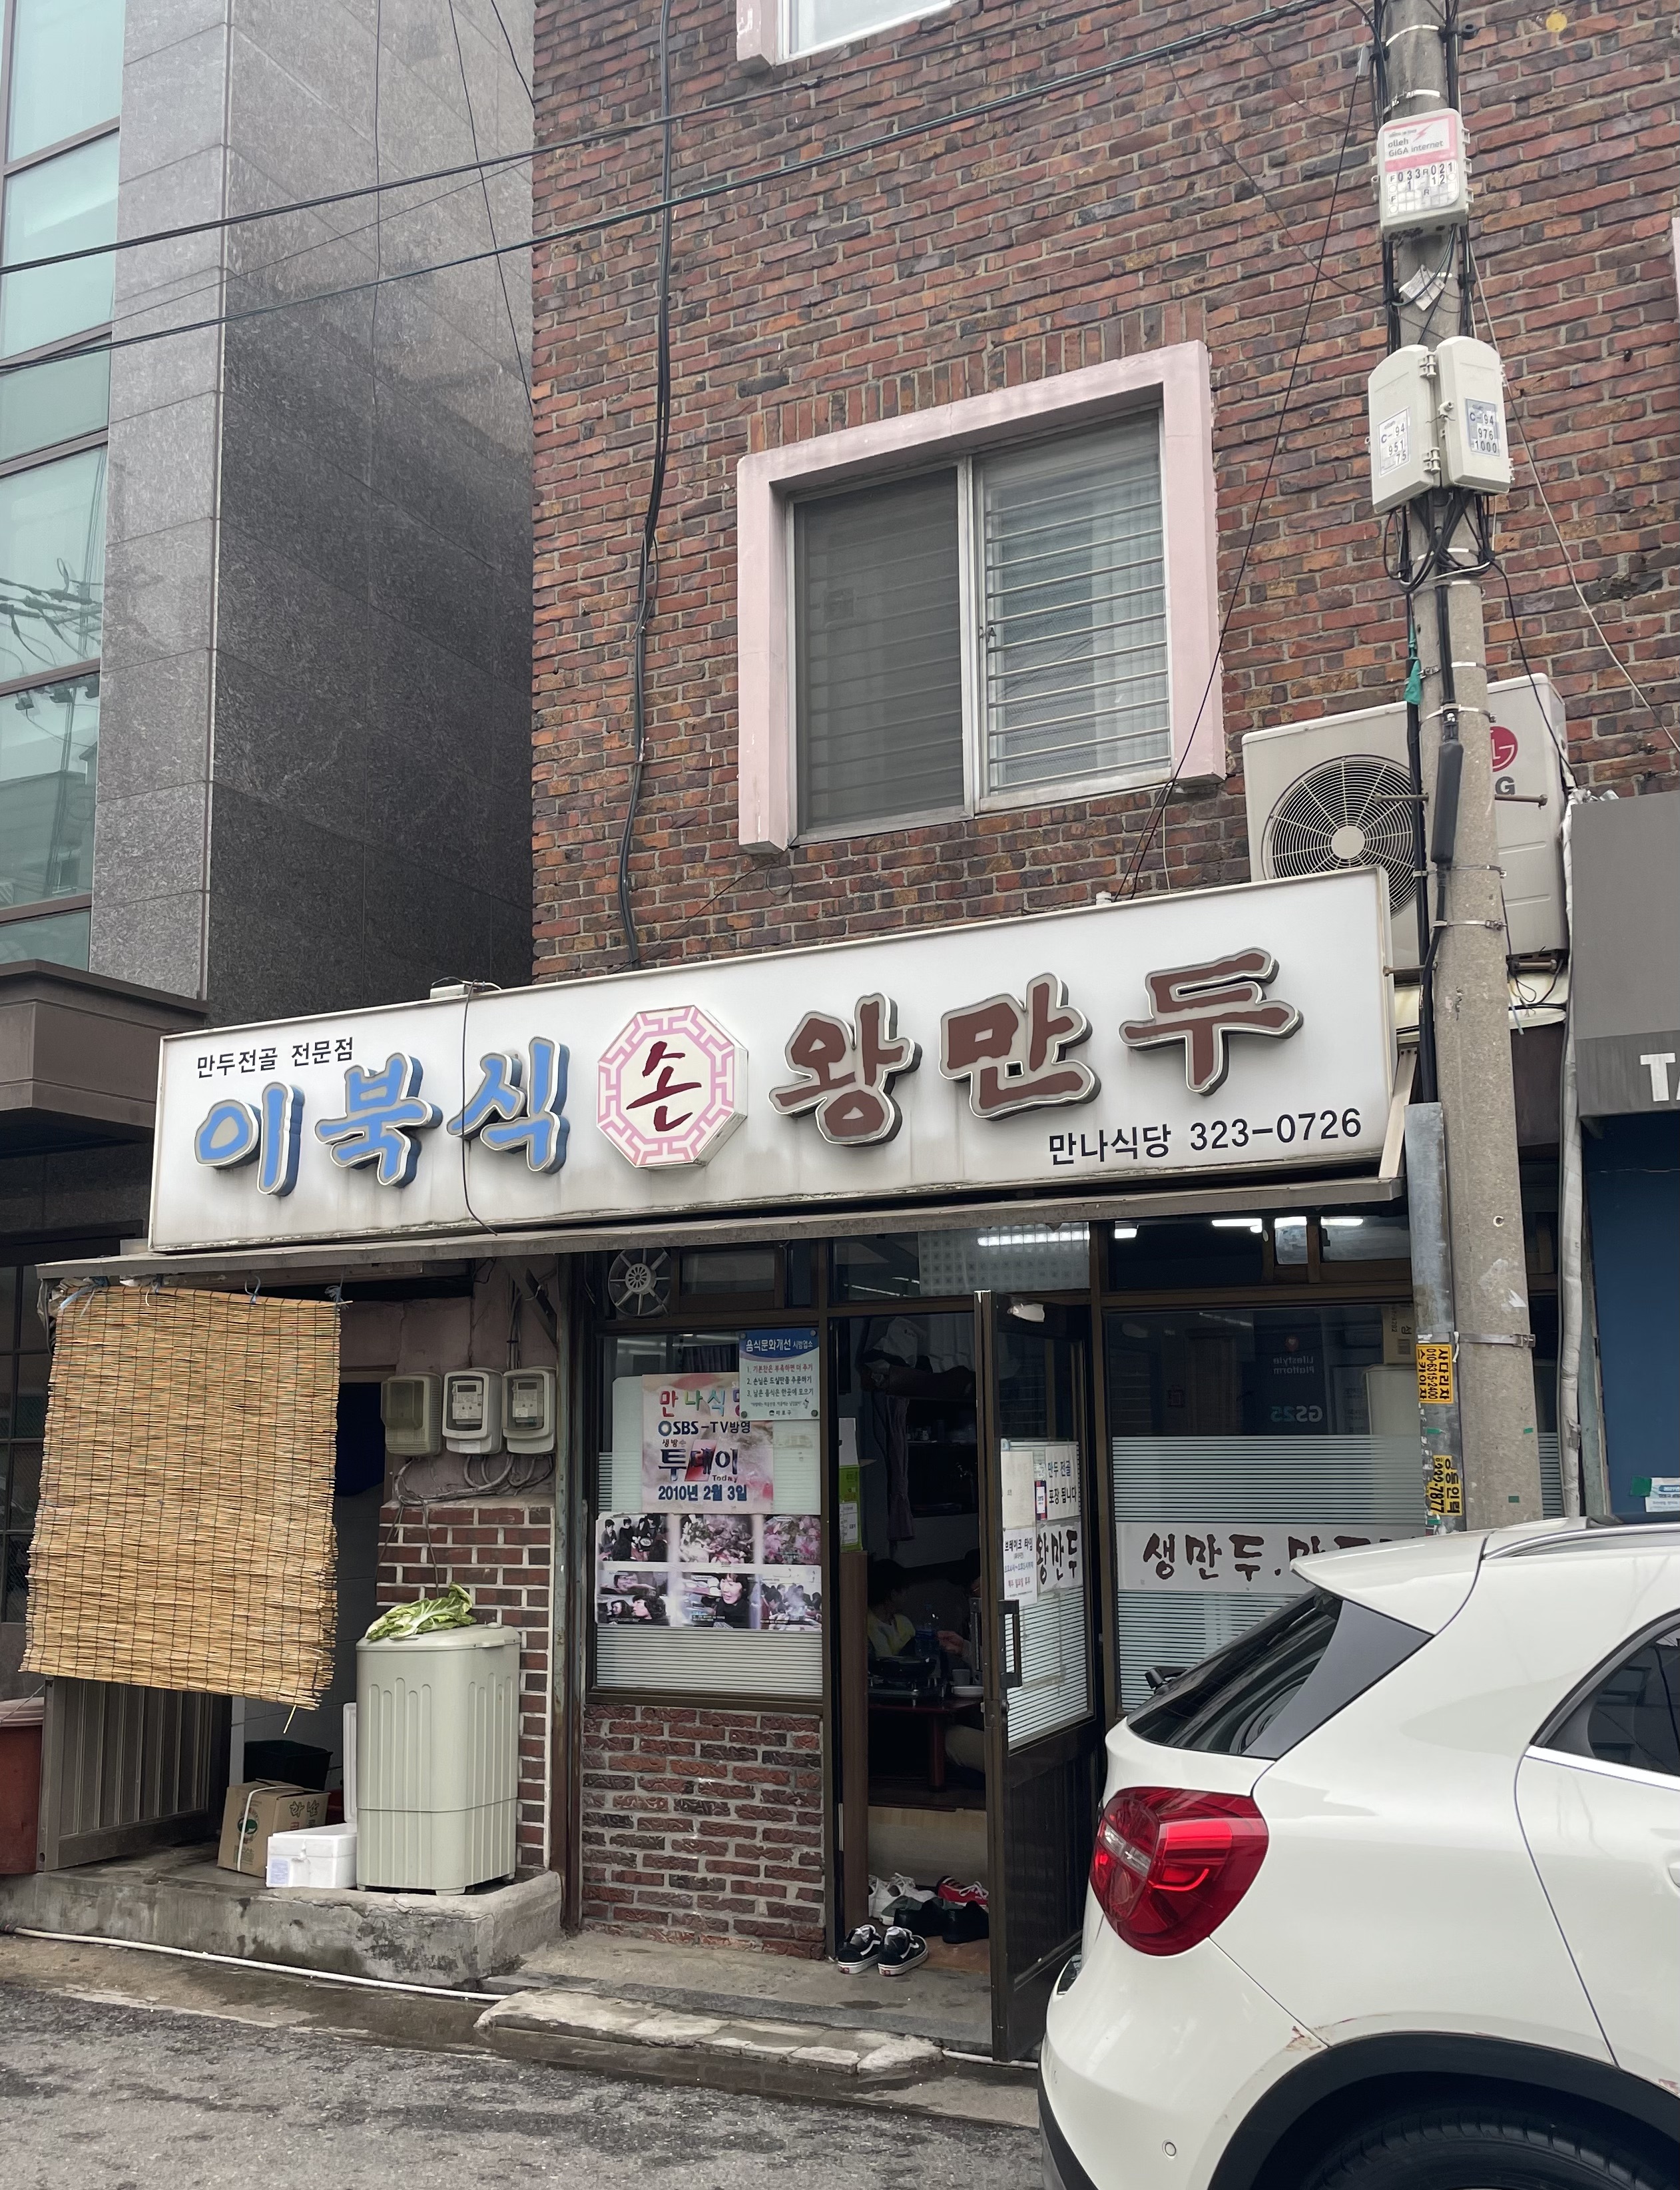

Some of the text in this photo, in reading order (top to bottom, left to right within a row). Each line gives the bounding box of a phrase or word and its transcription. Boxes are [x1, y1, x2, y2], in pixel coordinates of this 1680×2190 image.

[1388, 137, 1409, 148] olleh
[1388, 140, 1444, 157] GIGA internet
[1478, 428, 1494, 441] 976
[1388, 439, 1404, 456] 951
[1475, 440, 1497, 454] 1000
[1396, 450, 1406, 464] 75
[197, 1036, 353, 1078] 만두전골 전문점
[194, 946, 1304, 1197] 이북식 손 왕만두
[1640, 1052, 1680, 1102] T
[1049, 1108, 1362, 1166] 만나식당 323-0726
[745, 1338, 791, 1352] 음식문화개선
[752, 1377, 768, 1385] 손님은
[712, 1474, 738, 1483] Today
[658, 1484, 747, 1501] 2010년 2월 3일
[1036, 1529, 1078, 1585] 왕만두
